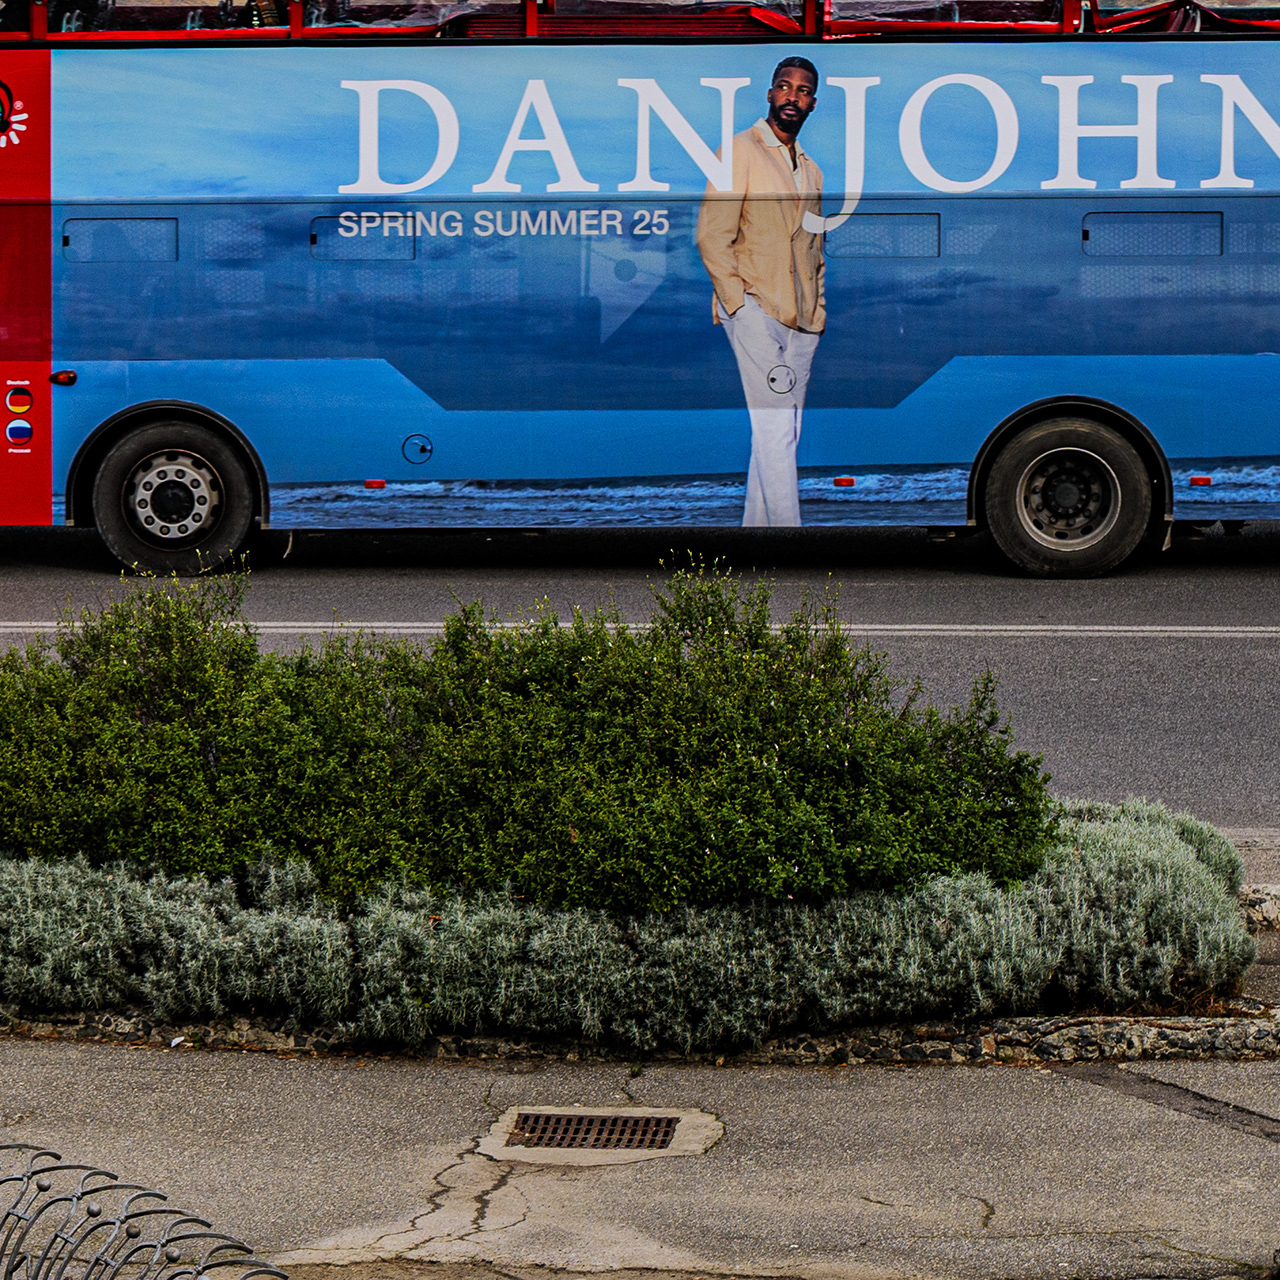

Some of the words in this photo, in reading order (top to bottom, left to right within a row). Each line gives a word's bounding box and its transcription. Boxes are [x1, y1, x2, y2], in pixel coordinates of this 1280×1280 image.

[337, 77, 752, 194] DAN
[337, 209, 463, 238] SPRING
[473, 208, 623, 237] SUMMER
[632, 208, 670, 236] 25
